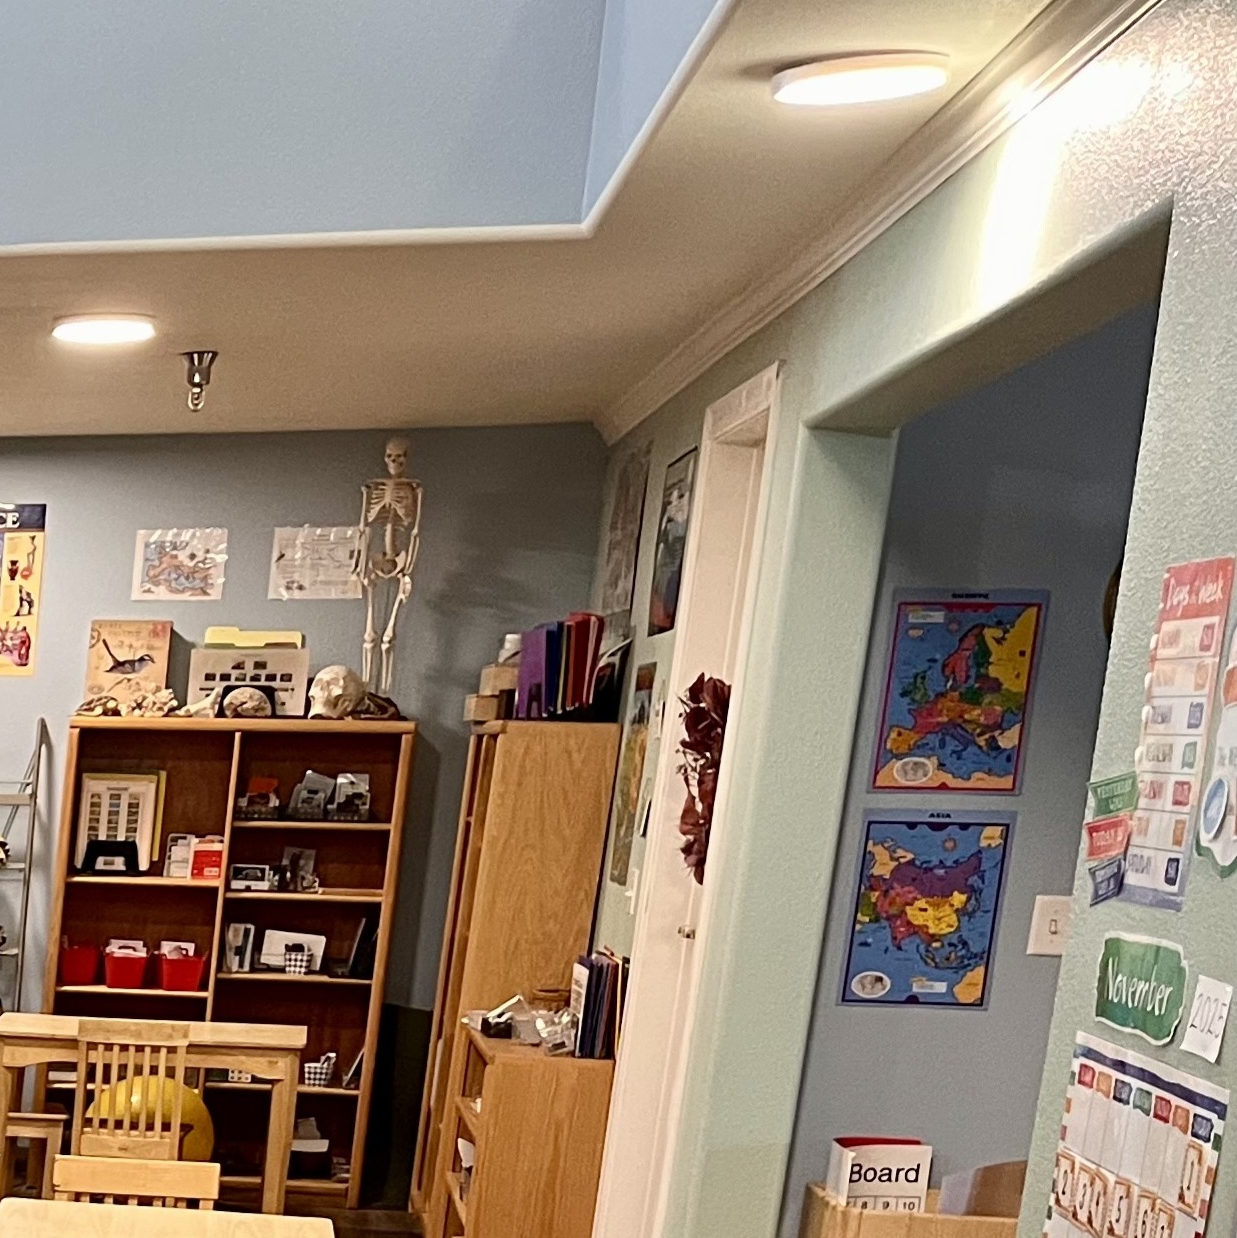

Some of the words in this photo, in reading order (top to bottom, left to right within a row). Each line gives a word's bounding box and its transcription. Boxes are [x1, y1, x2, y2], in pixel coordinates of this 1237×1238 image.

[1106, 957, 1173, 1016] November
[1190, 993, 1227, 1038] 2025
[849, 1163, 921, 1183] Board
[860, 1201, 868, 1210] 8
[882, 1201, 890, 1210] 9
[903, 1201, 915, 1211] 10
[1061, 1169, 1068, 1195] 2
[1080, 1183, 1087, 1210] 3
[1116, 1196, 1123, 1223] 5
[1140, 1209, 1148, 1238] 6
